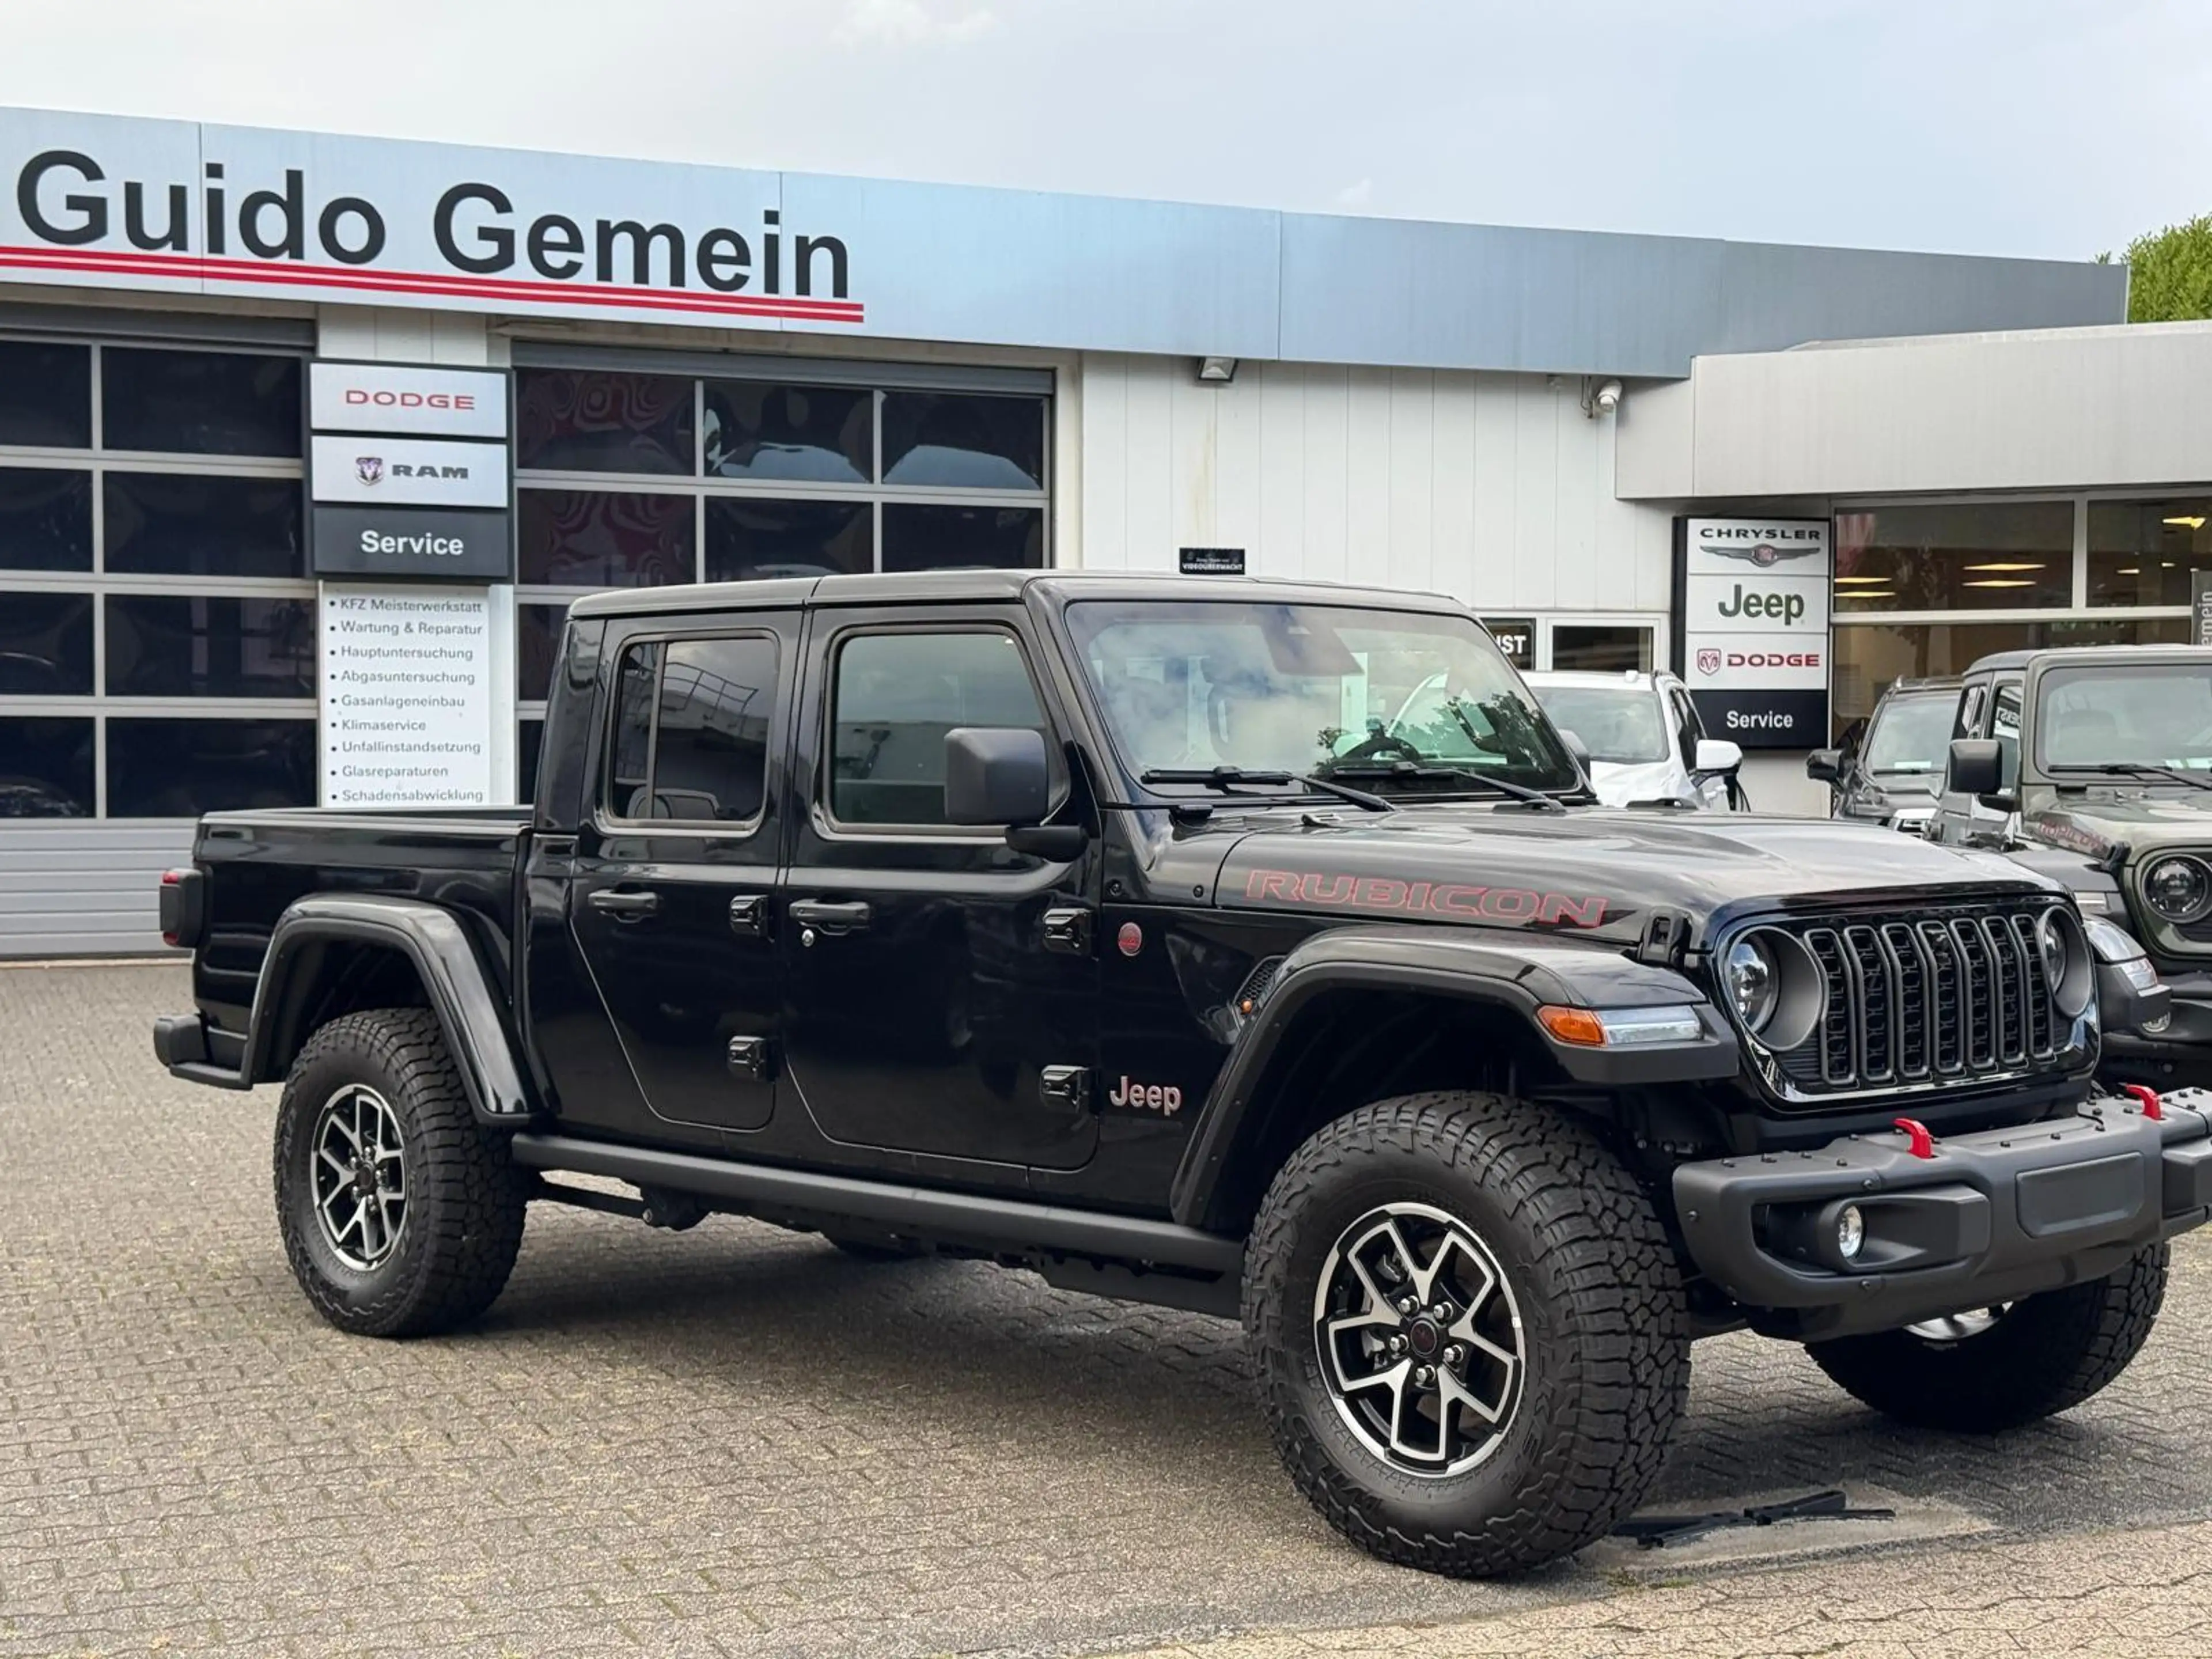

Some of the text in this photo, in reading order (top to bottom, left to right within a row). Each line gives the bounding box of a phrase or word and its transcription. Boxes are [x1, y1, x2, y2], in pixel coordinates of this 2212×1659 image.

[17, 150, 849, 298] Guido Gemein
[346, 390, 475, 410] DODGE
[392, 464, 469, 479] RAM
[1700, 528, 1820, 540] CHRYSLER
[361, 530, 464, 556] Service
[340, 597, 482, 612] KFZ Meisterwerkstatt
[1718, 584, 1805, 626] Jeep
[340, 620, 483, 636] Wartung & Reparatur
[340, 646, 474, 661] Hauptuntersuchung
[1727, 653, 1820, 667] DODGE
[340, 670, 476, 685] Abgasuntersuchung
[341, 694, 465, 710] Gasanlageneinbau
[342, 719, 427, 731] Klimaservice
[1726, 710, 1794, 729] Service
[342, 741, 481, 755] Unfallinstandsetzung
[342, 765, 449, 779] Glasreparaturen
[342, 789, 484, 803] Schadensabwicklung
[1245, 869, 1609, 928] RUBICON
[1109, 1075, 1182, 1116] Jeep
